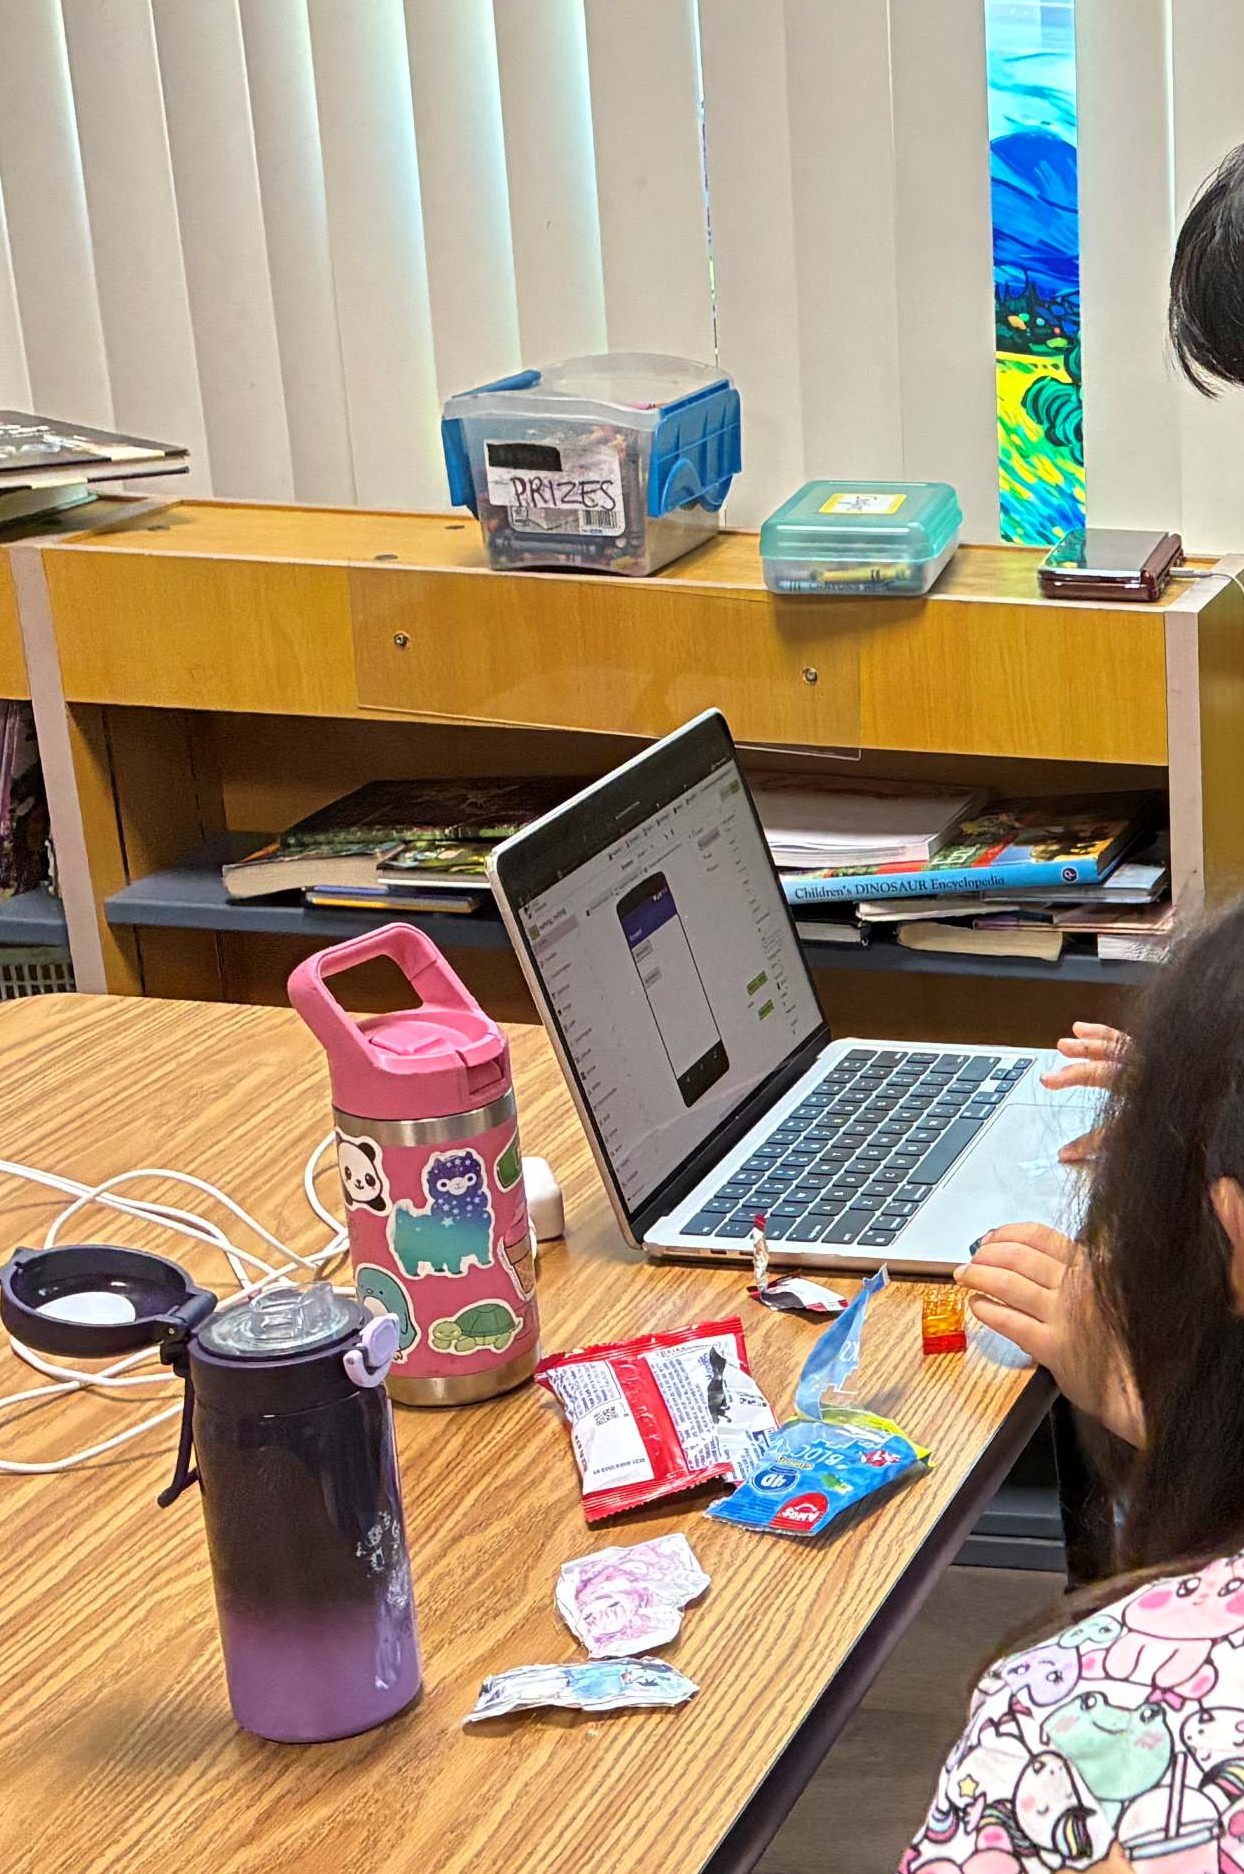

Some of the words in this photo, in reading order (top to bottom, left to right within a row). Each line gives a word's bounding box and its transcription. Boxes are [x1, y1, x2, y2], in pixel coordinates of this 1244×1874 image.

[510, 476, 617, 512] PRIZES
[794, 884, 853, 900] Children's
[855, 879, 928, 896] DINOSAUR
[931, 874, 1005, 892] Encyclopedia
[760, 1473, 788, 1488] 4D
